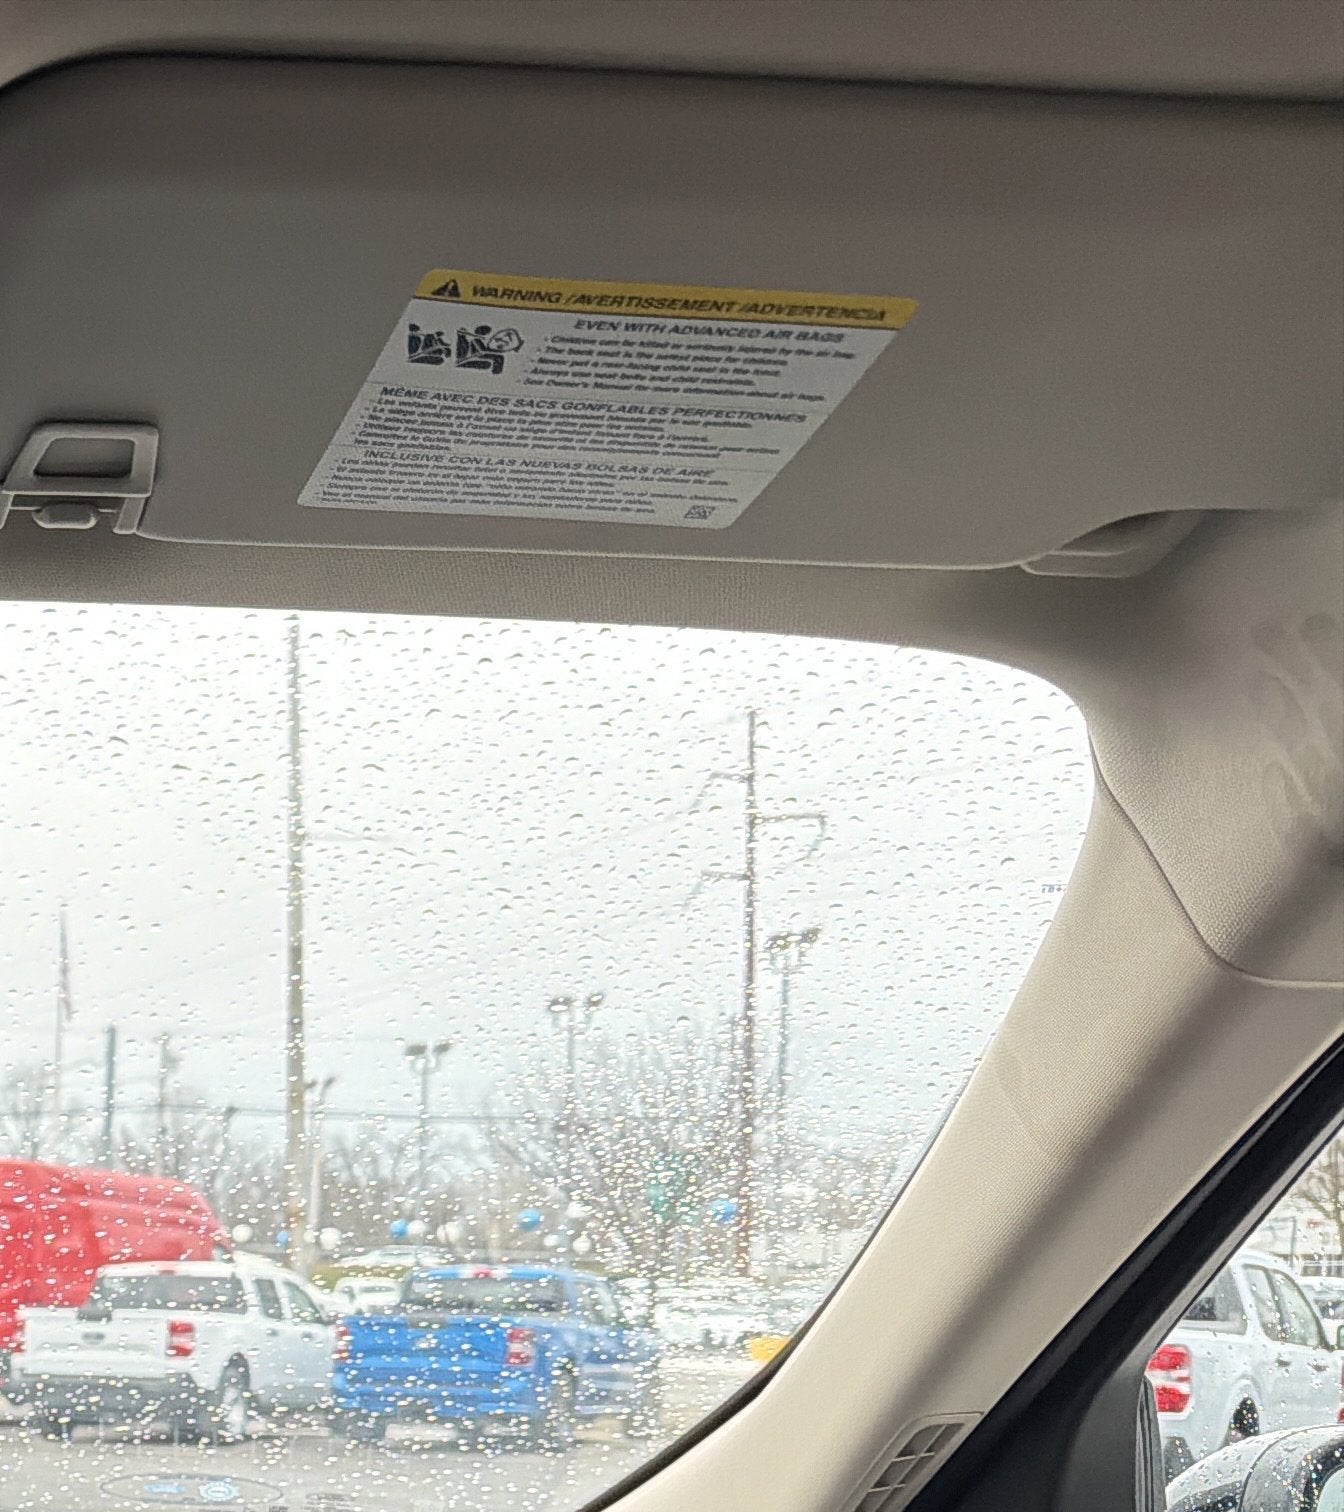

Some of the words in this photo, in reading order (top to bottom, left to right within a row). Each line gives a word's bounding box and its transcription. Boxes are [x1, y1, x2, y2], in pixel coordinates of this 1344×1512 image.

[472, 285, 562, 305] WARNING
[574, 319, 619, 331] EVEN
[622, 322, 667, 334] WITH
[668, 325, 761, 338] ADVANCED
[765, 330, 793, 341] AIR
[796, 332, 845, 344] BAGS
[431, 391, 474, 404] AVEC
[476, 395, 510, 406] DES
[514, 397, 557, 410] SACS
[561, 401, 669, 416] GONFLABLES
[672, 407, 808, 424] PERFECTIONNÉS
[363, 449, 446, 464] INCLUSIVE
[449, 455, 482, 466] CON
[485, 457, 518, 468] LAS
[519, 459, 582, 472] NUEVAS
[584, 462, 650, 475] BOLSAS
[651, 466, 673, 476] DE
[675, 467, 715, 478] AIRE
